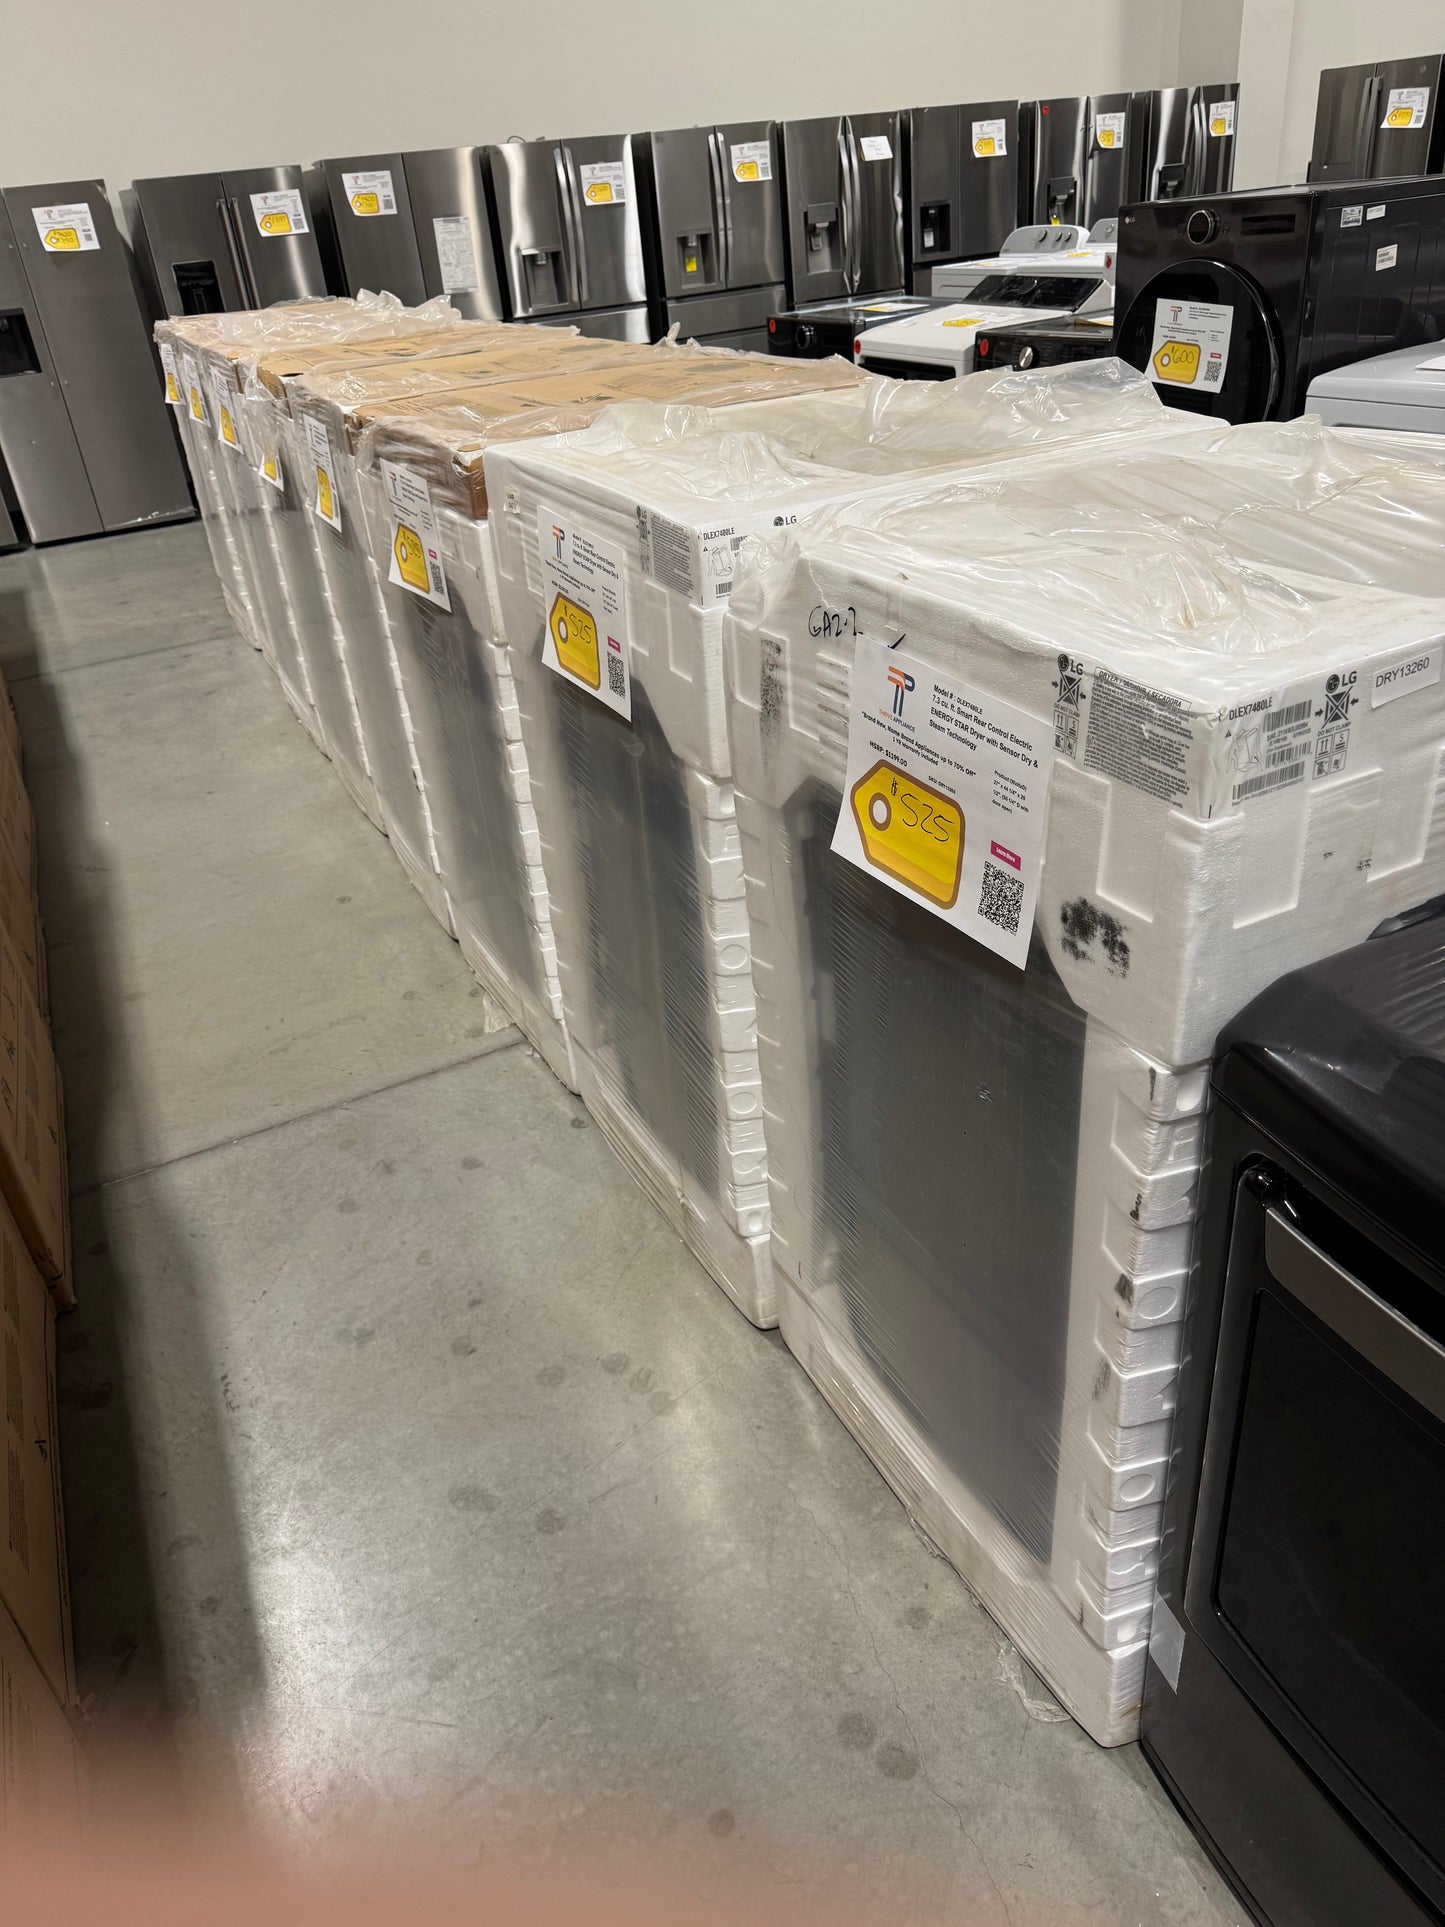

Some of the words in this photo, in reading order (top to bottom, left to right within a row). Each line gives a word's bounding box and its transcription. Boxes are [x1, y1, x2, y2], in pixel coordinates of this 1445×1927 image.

[1171, 345, 1195, 364] $600
[785, 515, 797, 526] LG
[1376, 657, 1430, 688] DRY13260
[934, 684, 948, 697] Model
[1099, 670, 1118, 682] DRYER
[1152, 690, 1182, 708] SECADORA
[1229, 697, 1273, 720] DLEX7480LE
[893, 717, 915, 733] APPLIANCE
[929, 719, 945, 733] Steam
[947, 728, 977, 751] Technology
[932, 695, 940, 704] 7.3
[941, 700, 949, 709] cu.
[957, 707, 972, 721] Smart
[974, 716, 987, 728] Rear
[988, 723, 1009, 739] Control
[1010, 734, 1033, 751] Electric
[902, 742, 920, 756] Warranty
[931, 707, 954, 723] ENERGY
[954, 720, 969, 733] STAR
[970, 727, 985, 741] Dryer
[986, 736, 998, 748] with
[999, 743, 1020, 759] Sensor
[1021, 753, 1032, 767] Dry
[1033, 760, 1039, 768] &
[870, 741, 884, 754] MSRP:
[885, 749, 907, 767] $1199.00
[901, 733, 914, 745] Brand
[915, 741, 939, 759] Appliances
[954, 762, 964, 772] 70%
[891, 777, 954, 842] $525
